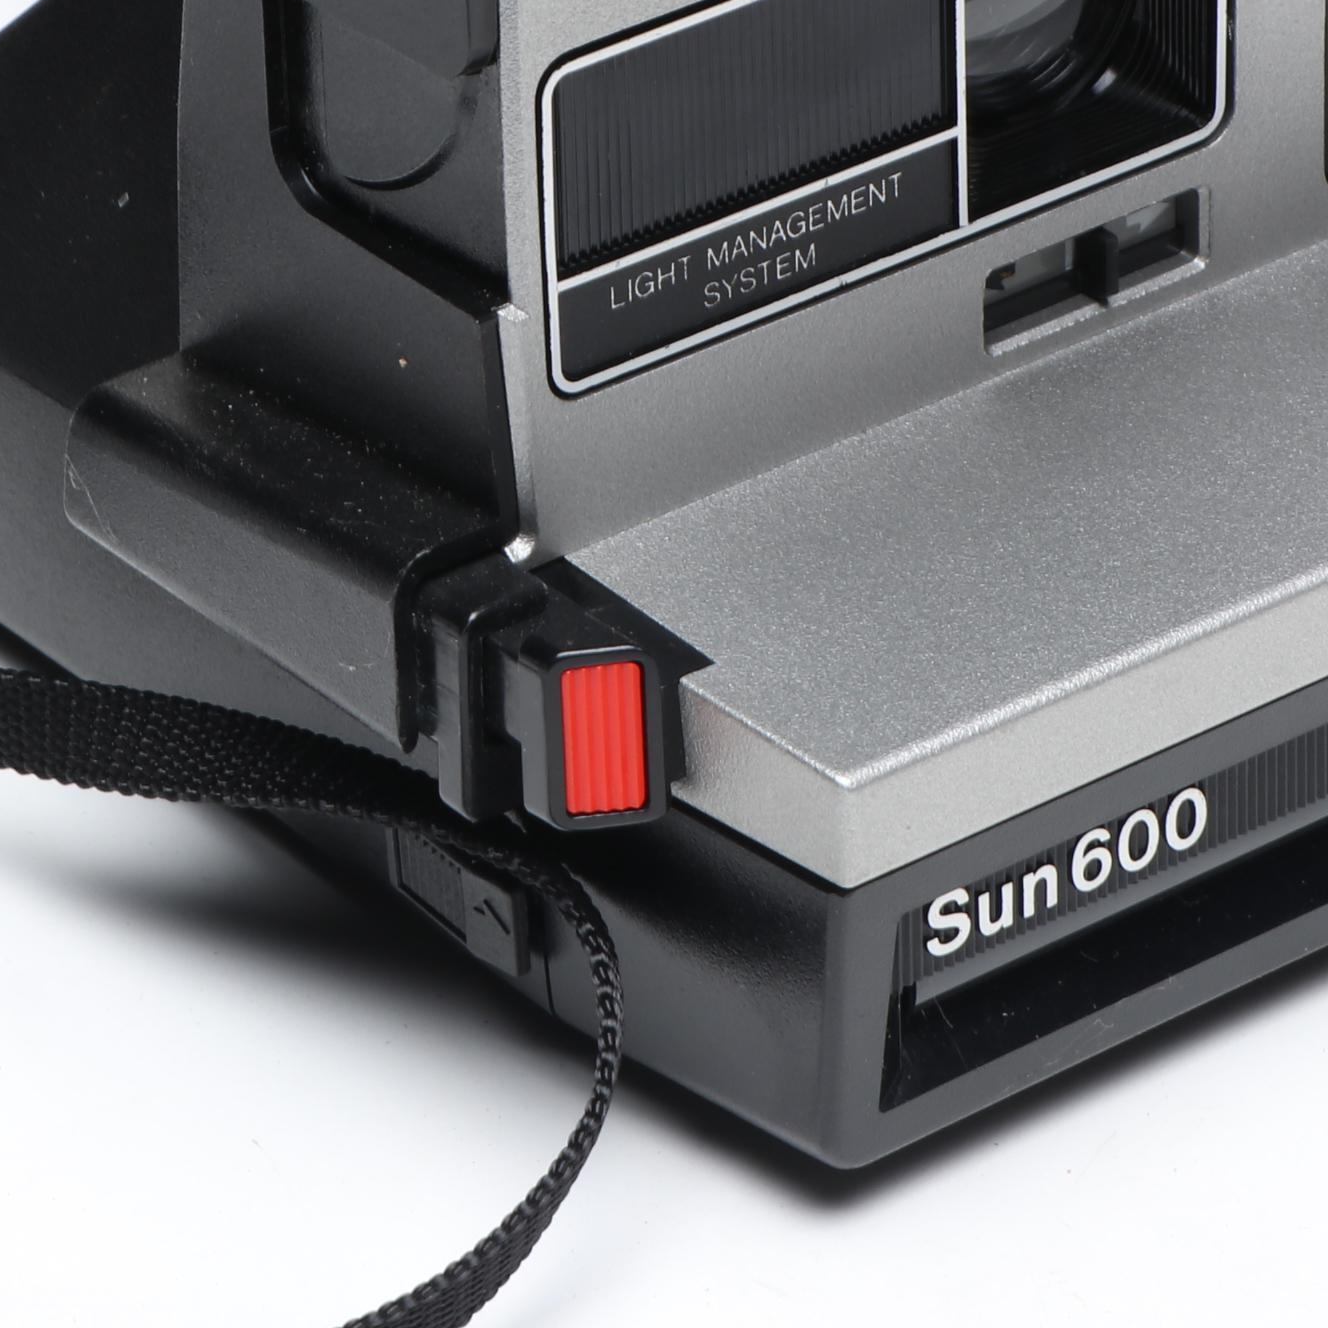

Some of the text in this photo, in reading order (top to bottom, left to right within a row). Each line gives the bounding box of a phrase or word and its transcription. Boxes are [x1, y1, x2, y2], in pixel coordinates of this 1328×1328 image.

[609, 171, 903, 310] LIGHT MANAGEMENT
[703, 242, 817, 308] SYSTEM
